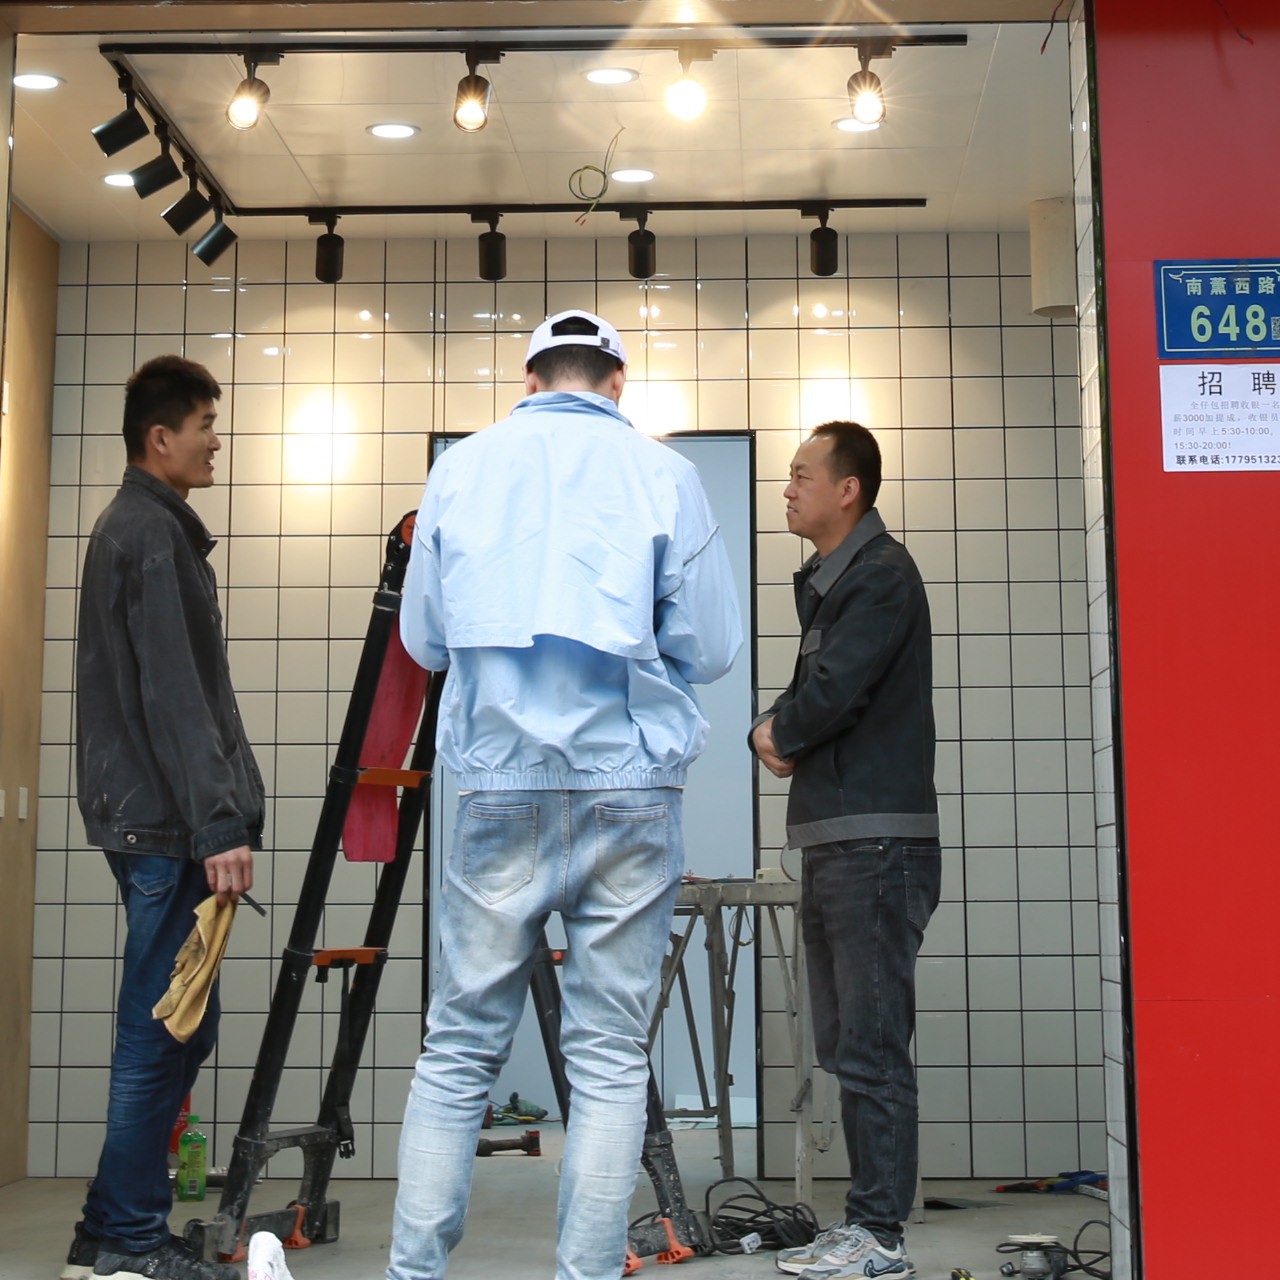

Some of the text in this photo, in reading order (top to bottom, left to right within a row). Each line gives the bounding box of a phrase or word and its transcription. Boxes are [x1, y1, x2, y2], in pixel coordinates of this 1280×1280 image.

[1185, 276, 1277, 296] 南薰西路
[1190, 304, 1267, 343] 648
[1198, 370, 1277, 396] 招聘
